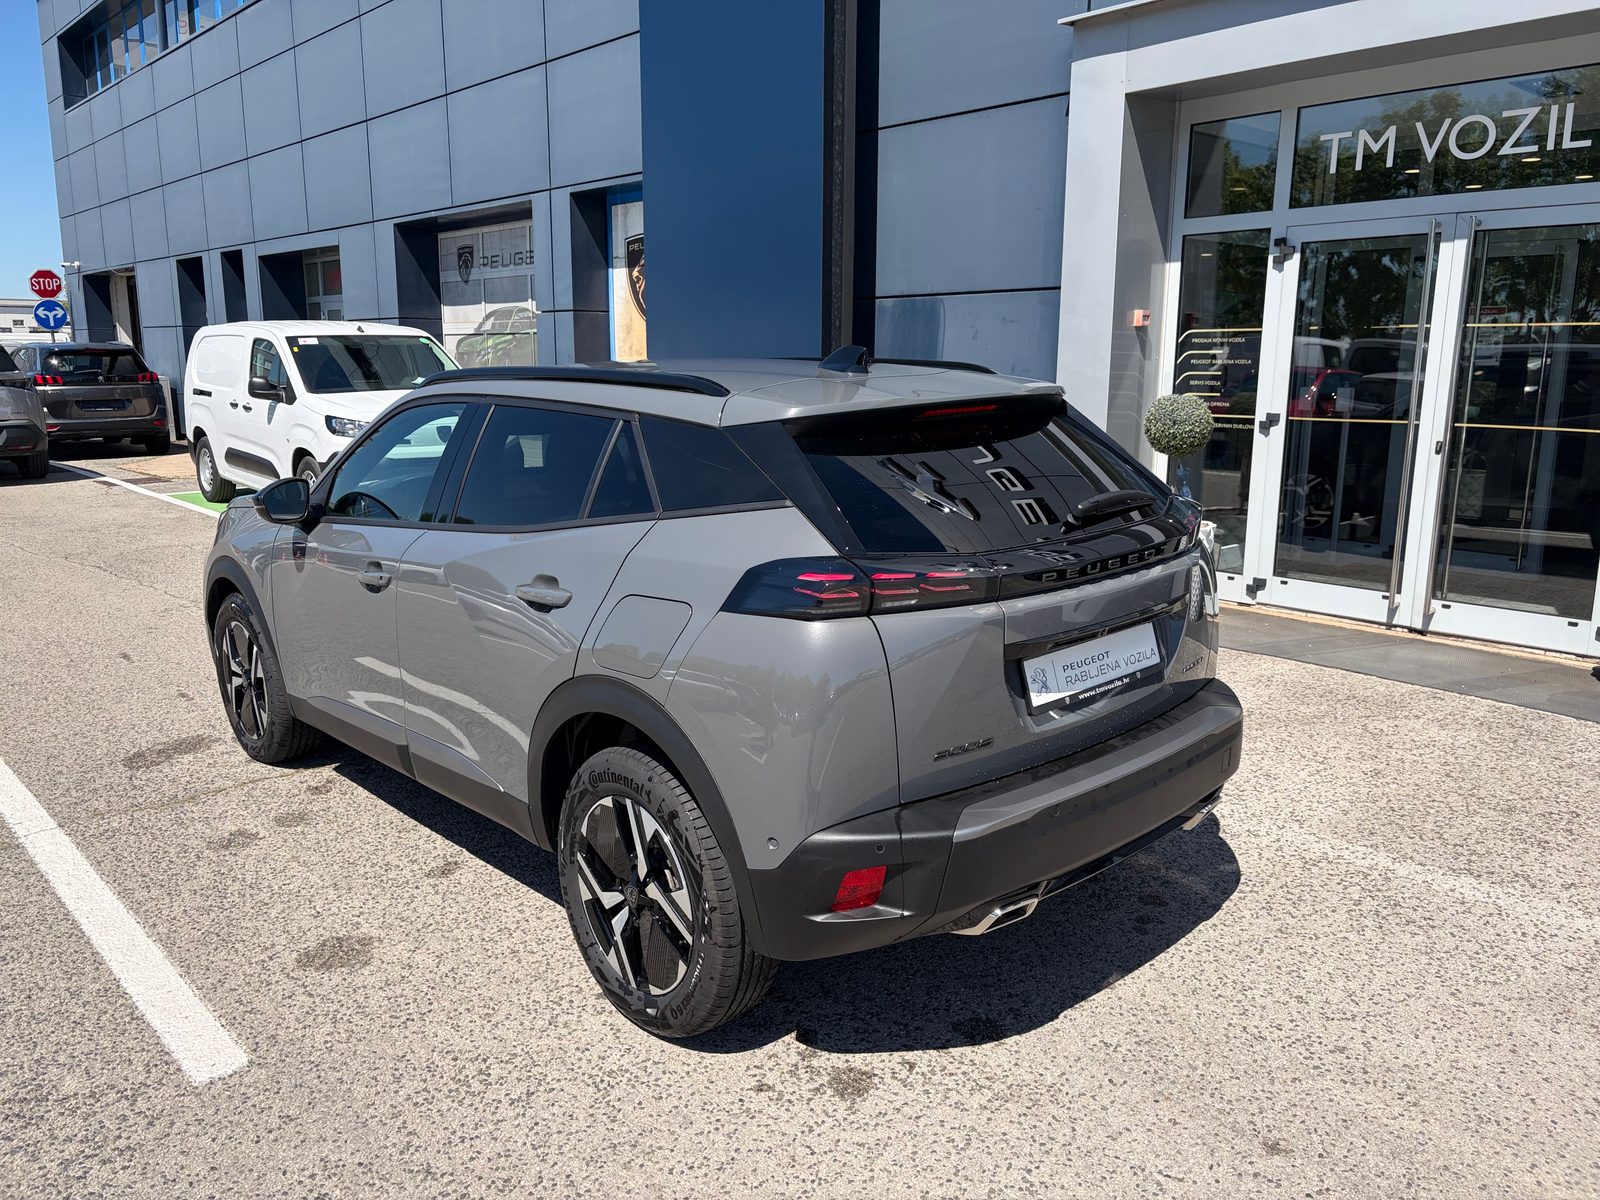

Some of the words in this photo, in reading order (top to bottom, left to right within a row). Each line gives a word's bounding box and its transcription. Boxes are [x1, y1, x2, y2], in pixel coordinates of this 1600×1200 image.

[1320, 125, 1397, 174] TM
[1415, 103, 1592, 163] VOZIL
[31, 278, 60, 290] STOP
[1062, 650, 1111, 673] PEUGEOT
[1065, 662, 1121, 687] RABLJENA
[1122, 647, 1157, 667] VOZILA
[1078, 677, 1130, 700] www.tmvozila.hr
[589, 768, 645, 797] Continental
